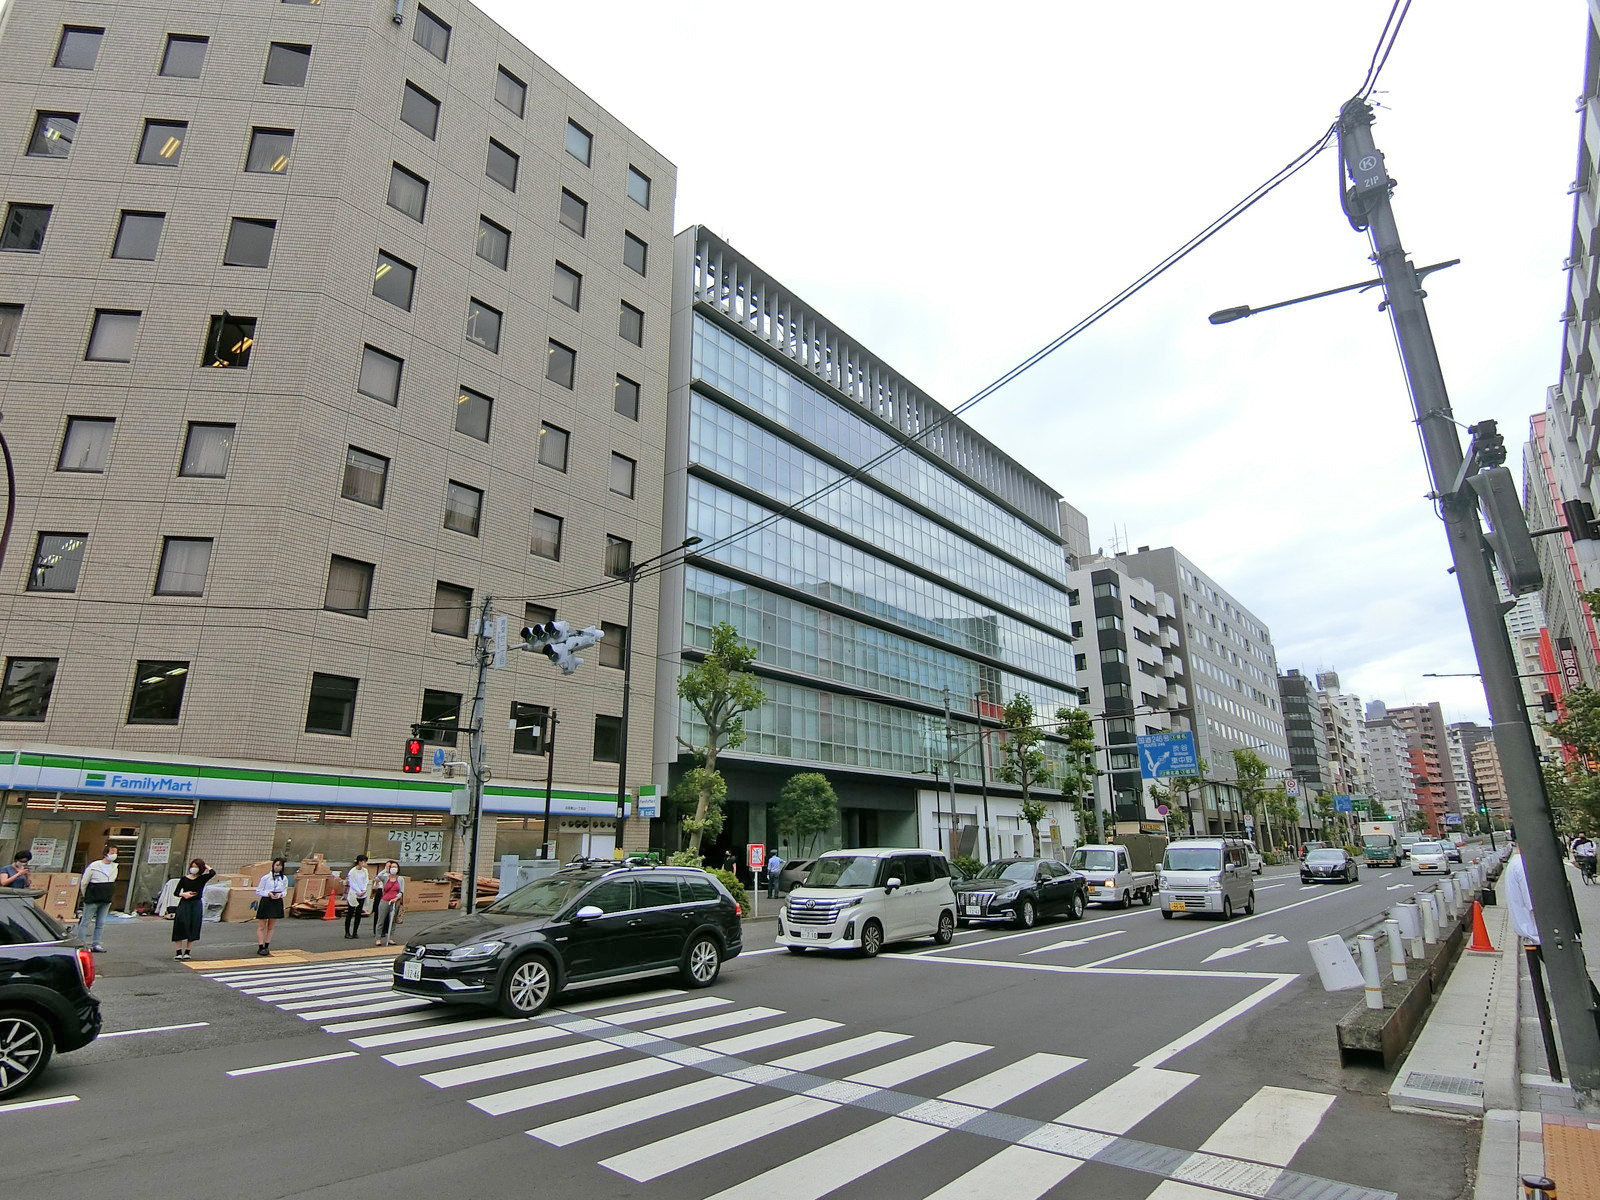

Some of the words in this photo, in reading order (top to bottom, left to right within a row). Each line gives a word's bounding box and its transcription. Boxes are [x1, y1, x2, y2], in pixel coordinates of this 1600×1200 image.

[111, 775, 193, 792] FamilyMart
[389, 830, 443, 841] ファミリーマート
